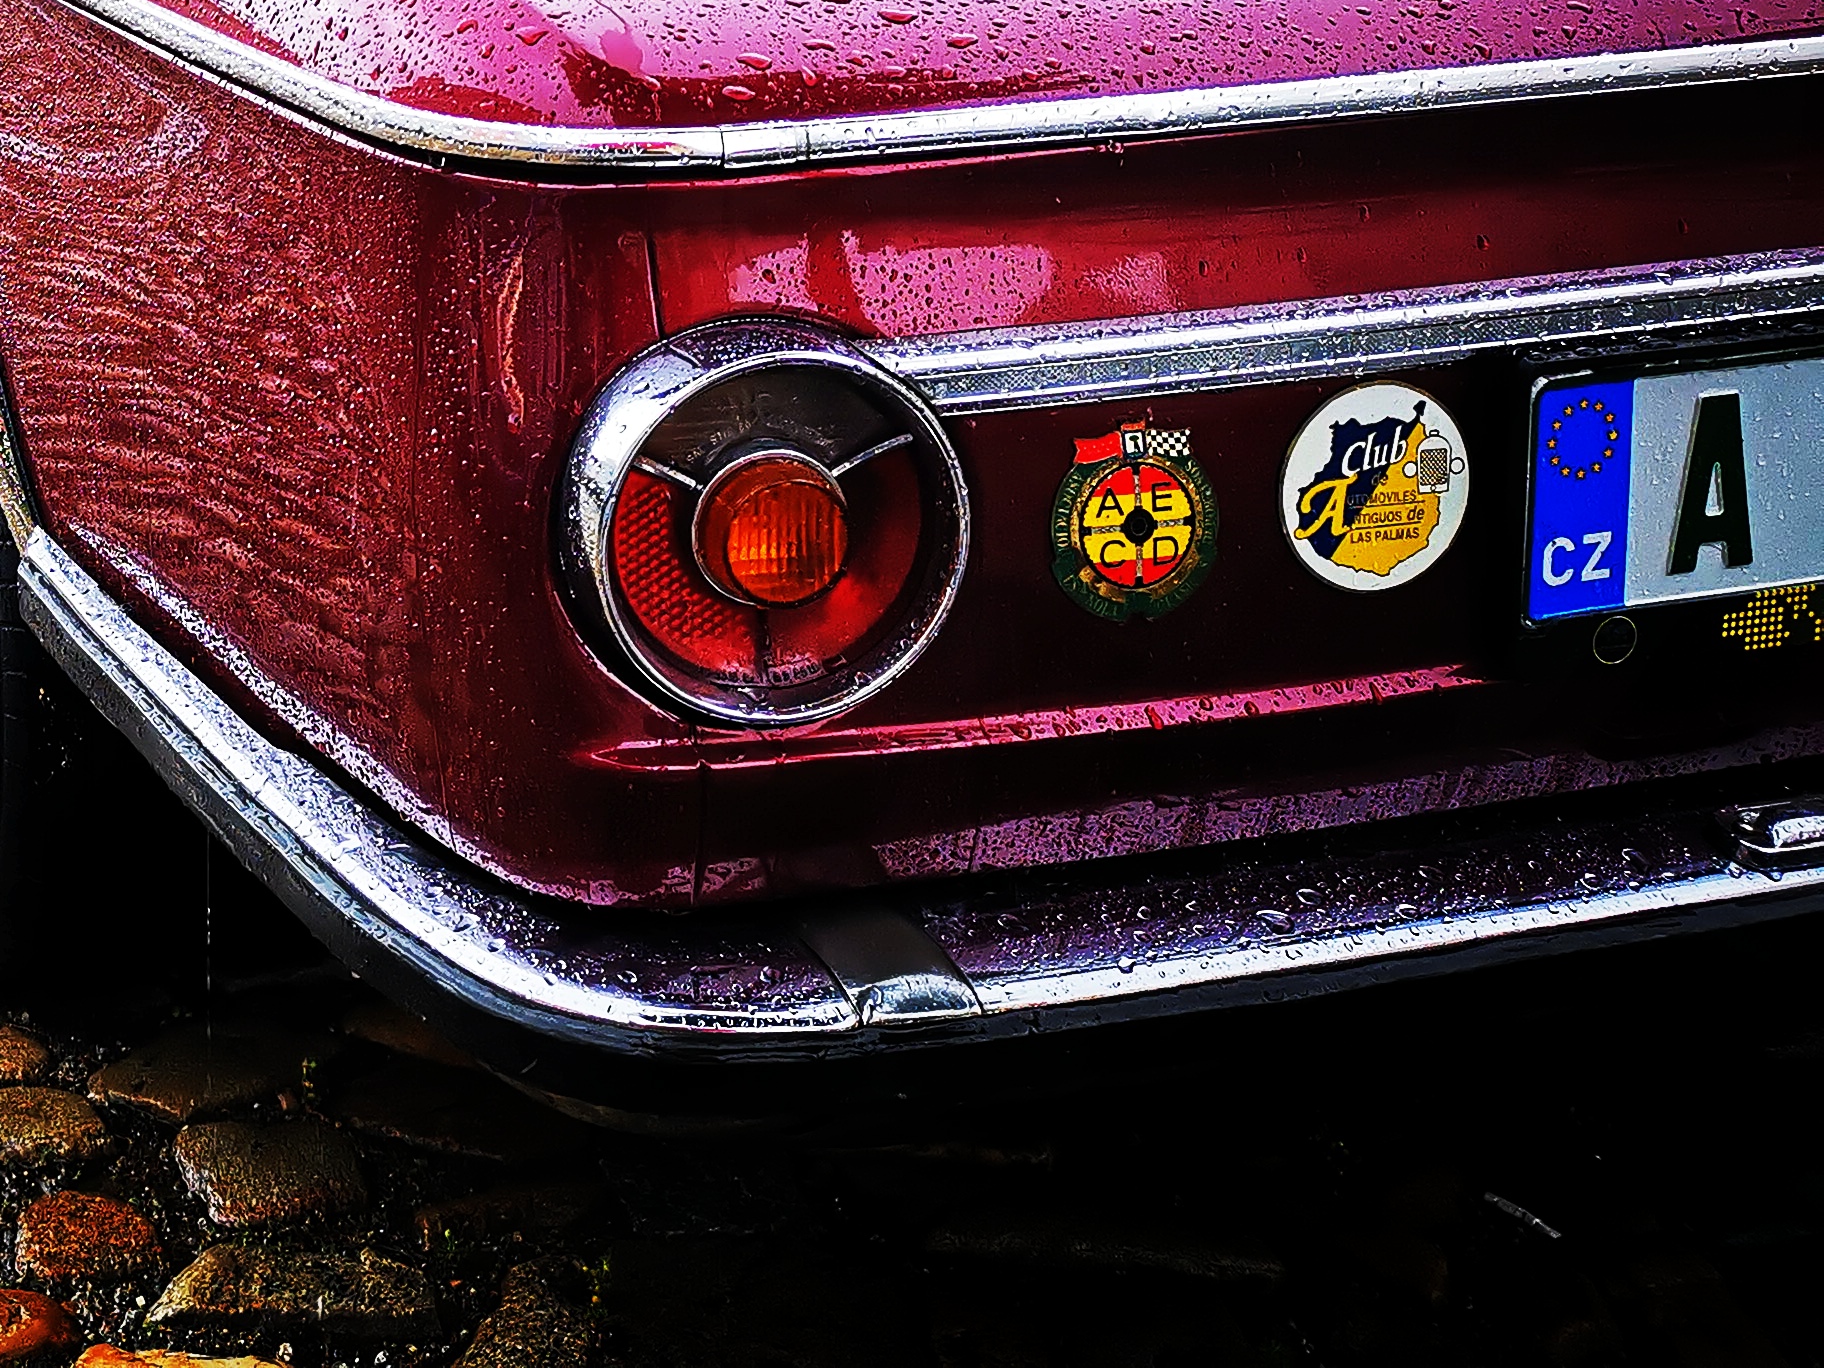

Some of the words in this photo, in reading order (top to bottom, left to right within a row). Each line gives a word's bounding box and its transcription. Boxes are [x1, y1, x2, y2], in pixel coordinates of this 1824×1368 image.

[1341, 425, 1408, 477] Club
[1665, 388, 1754, 577] A
[1349, 530, 1372, 544] LAS
[1375, 527, 1420, 542] PALMAS
[1406, 505, 1425, 522] de
[1542, 531, 1613, 587] CZ
